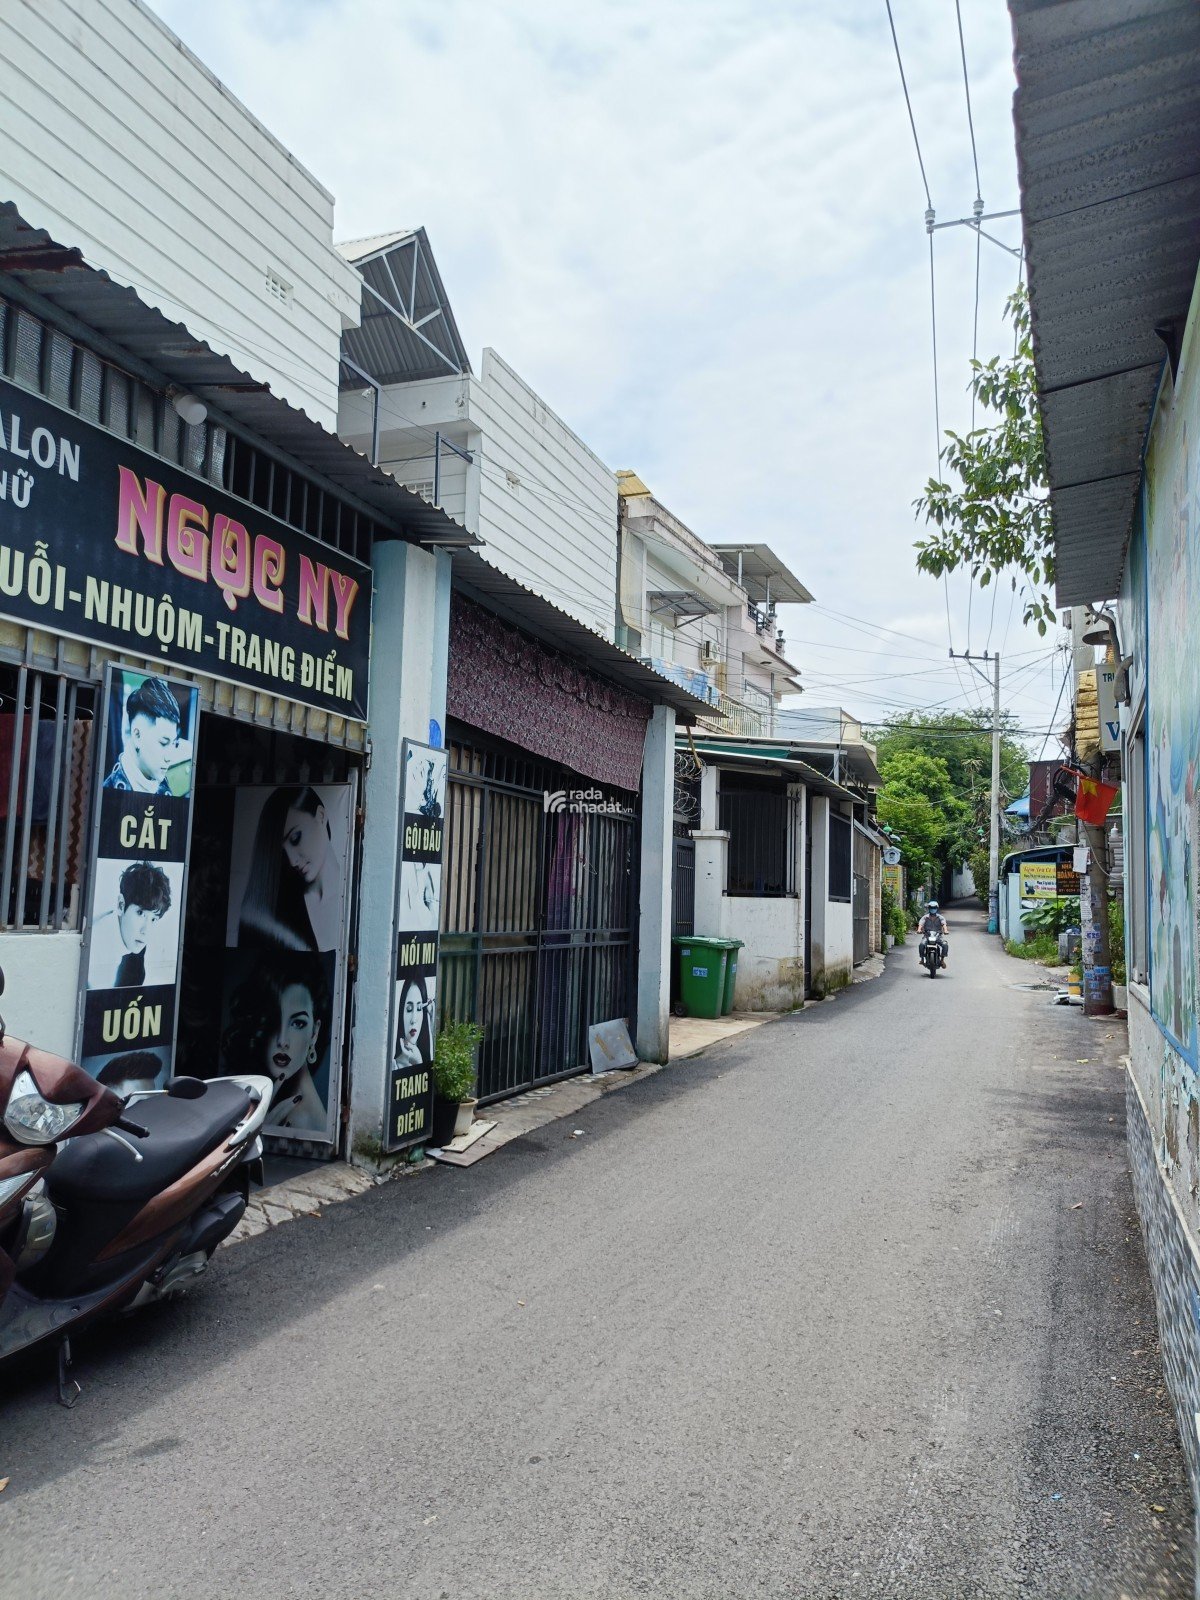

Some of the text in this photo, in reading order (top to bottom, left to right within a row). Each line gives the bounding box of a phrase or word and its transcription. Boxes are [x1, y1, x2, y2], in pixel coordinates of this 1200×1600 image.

[115, 464, 359, 640] NGỌC NY
[300, 649, 353, 701] ĐIỂM
[1102, 672, 1115, 682] TR
[119, 805, 172, 851] CẮT
[405, 822, 422, 855] GỘI
[400, 935, 436, 967] NỐI MI
[102, 995, 162, 1043] UỐN
[395, 1071, 429, 1101] TRANG
[397, 1102, 425, 1137] ĐIỂM
